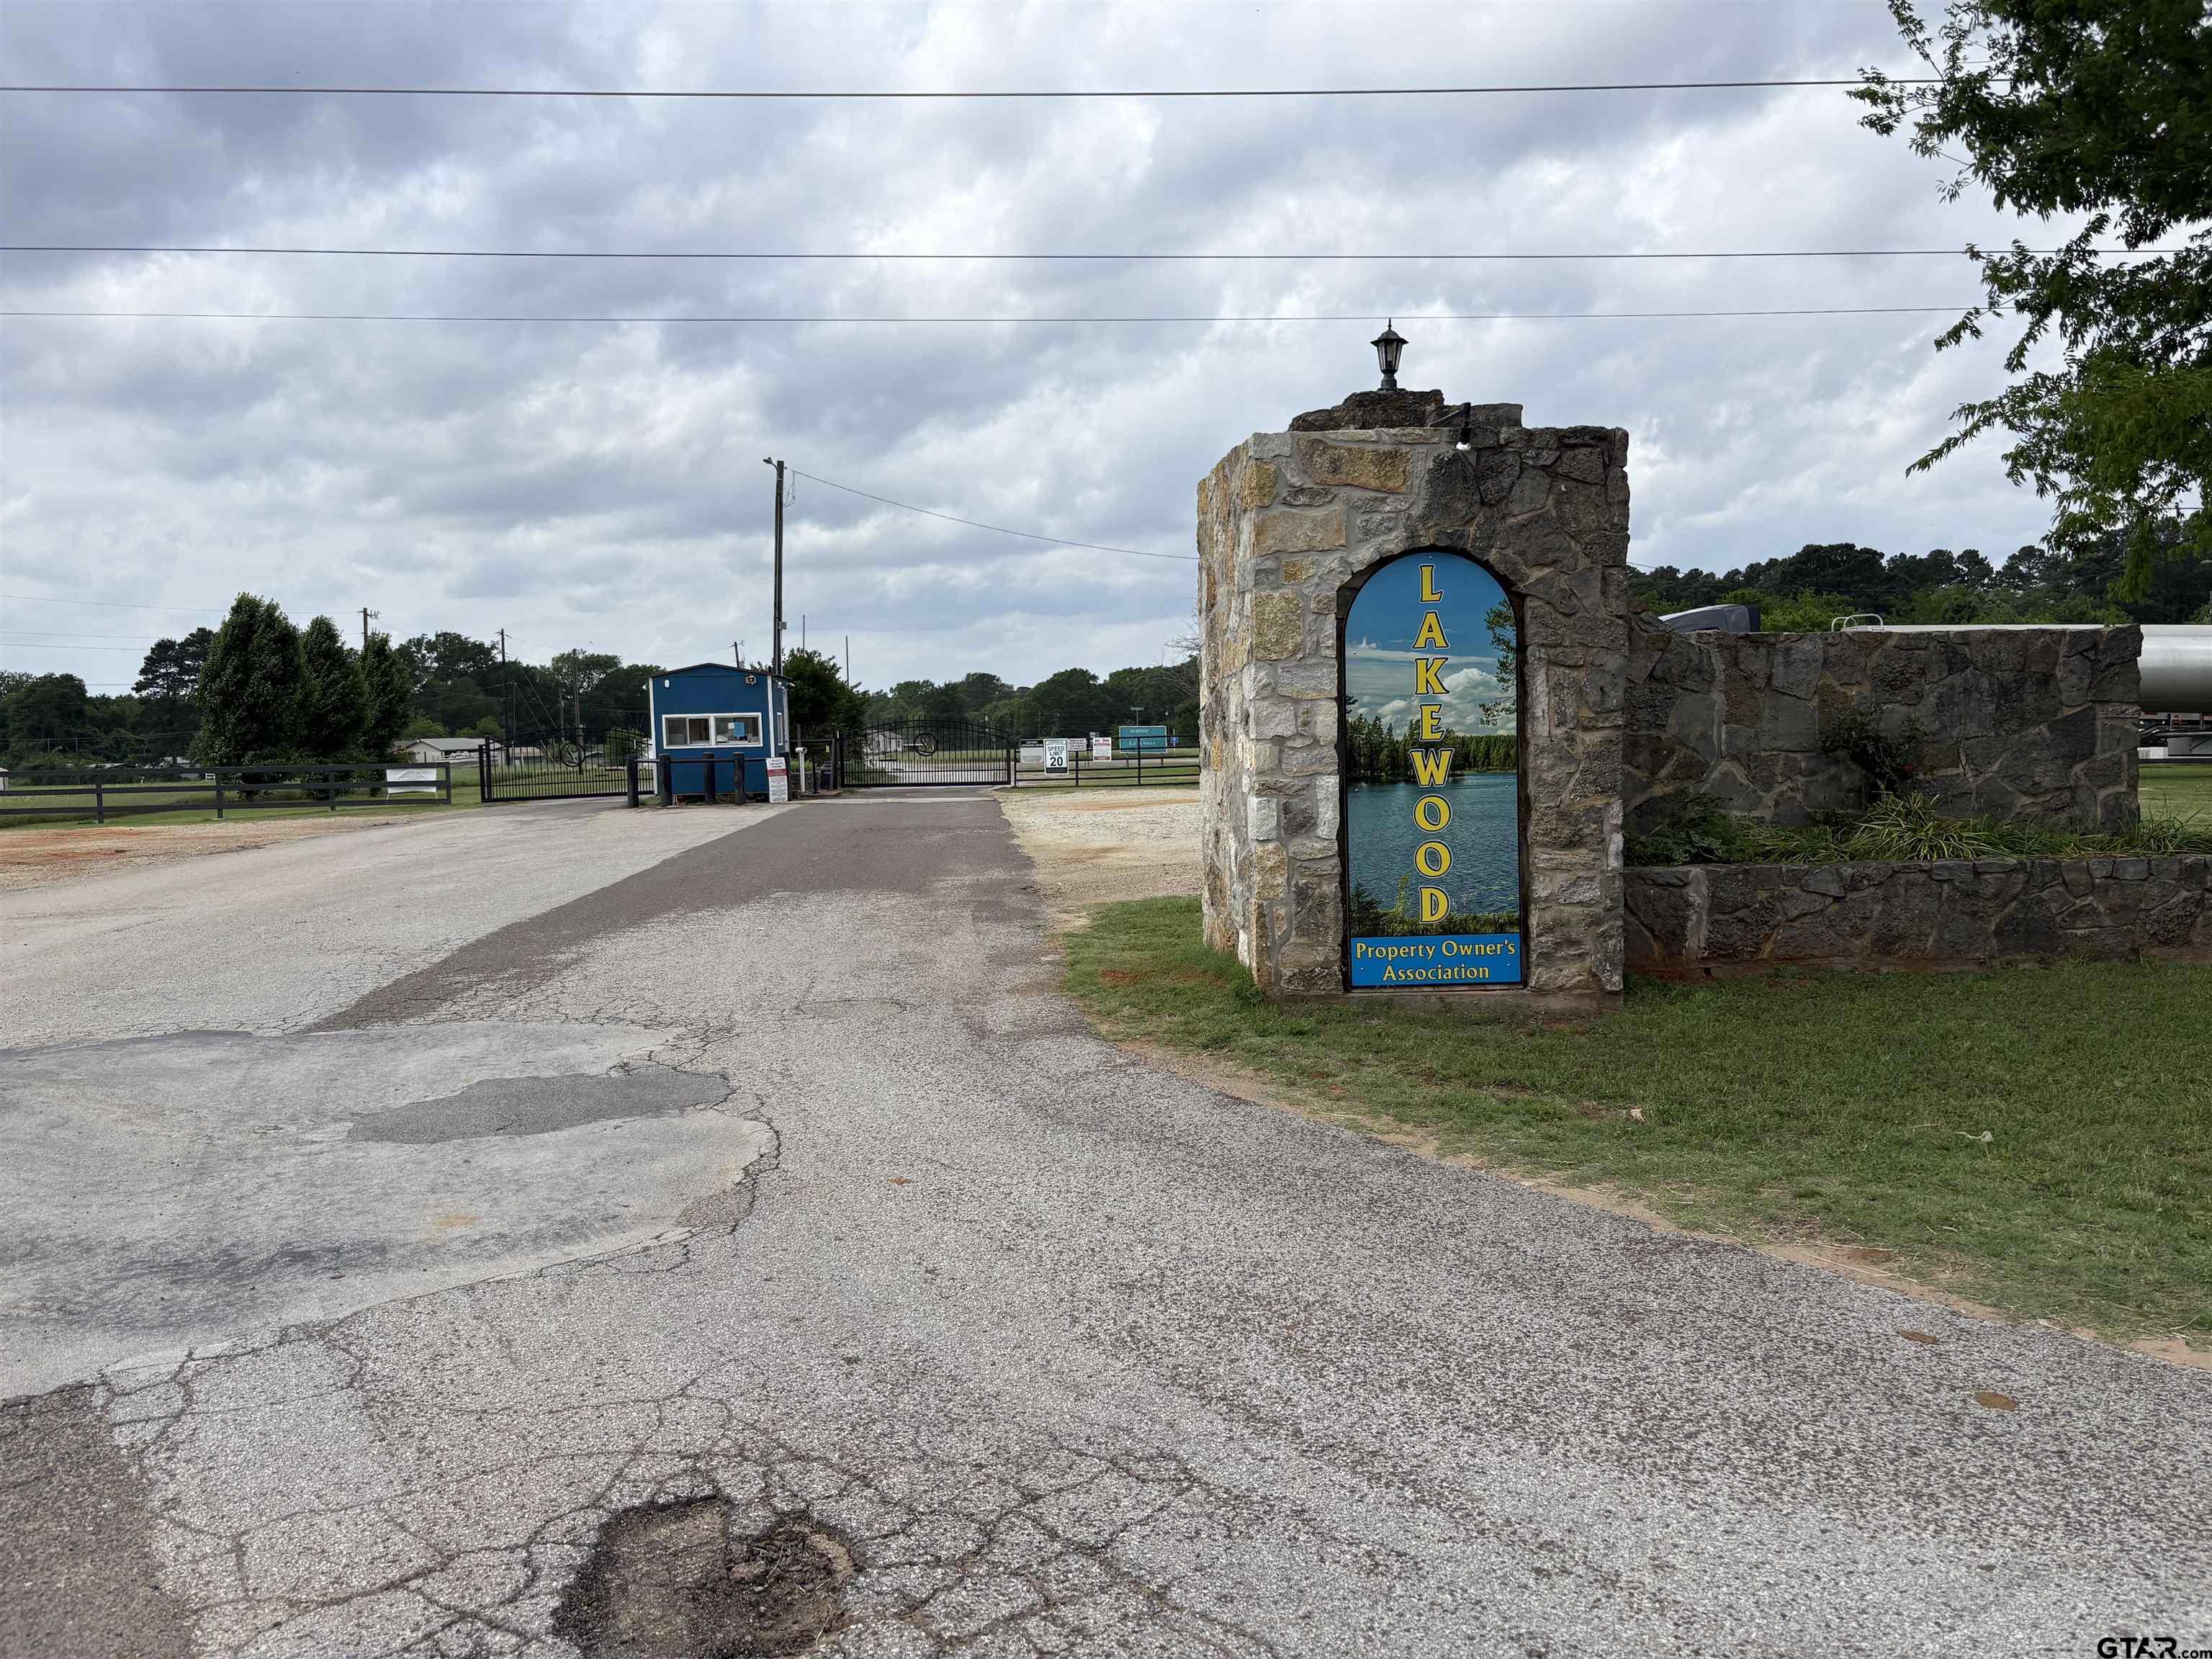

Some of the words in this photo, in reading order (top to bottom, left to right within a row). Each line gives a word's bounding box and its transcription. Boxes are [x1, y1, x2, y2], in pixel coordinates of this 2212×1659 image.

[1409, 564, 1455, 923] LAKEWOOD
[1050, 756, 1064, 766] 20
[1355, 942, 1436, 961] Property
[1442, 939, 1516, 957] Owner's
[1382, 964, 1490, 981] Association
